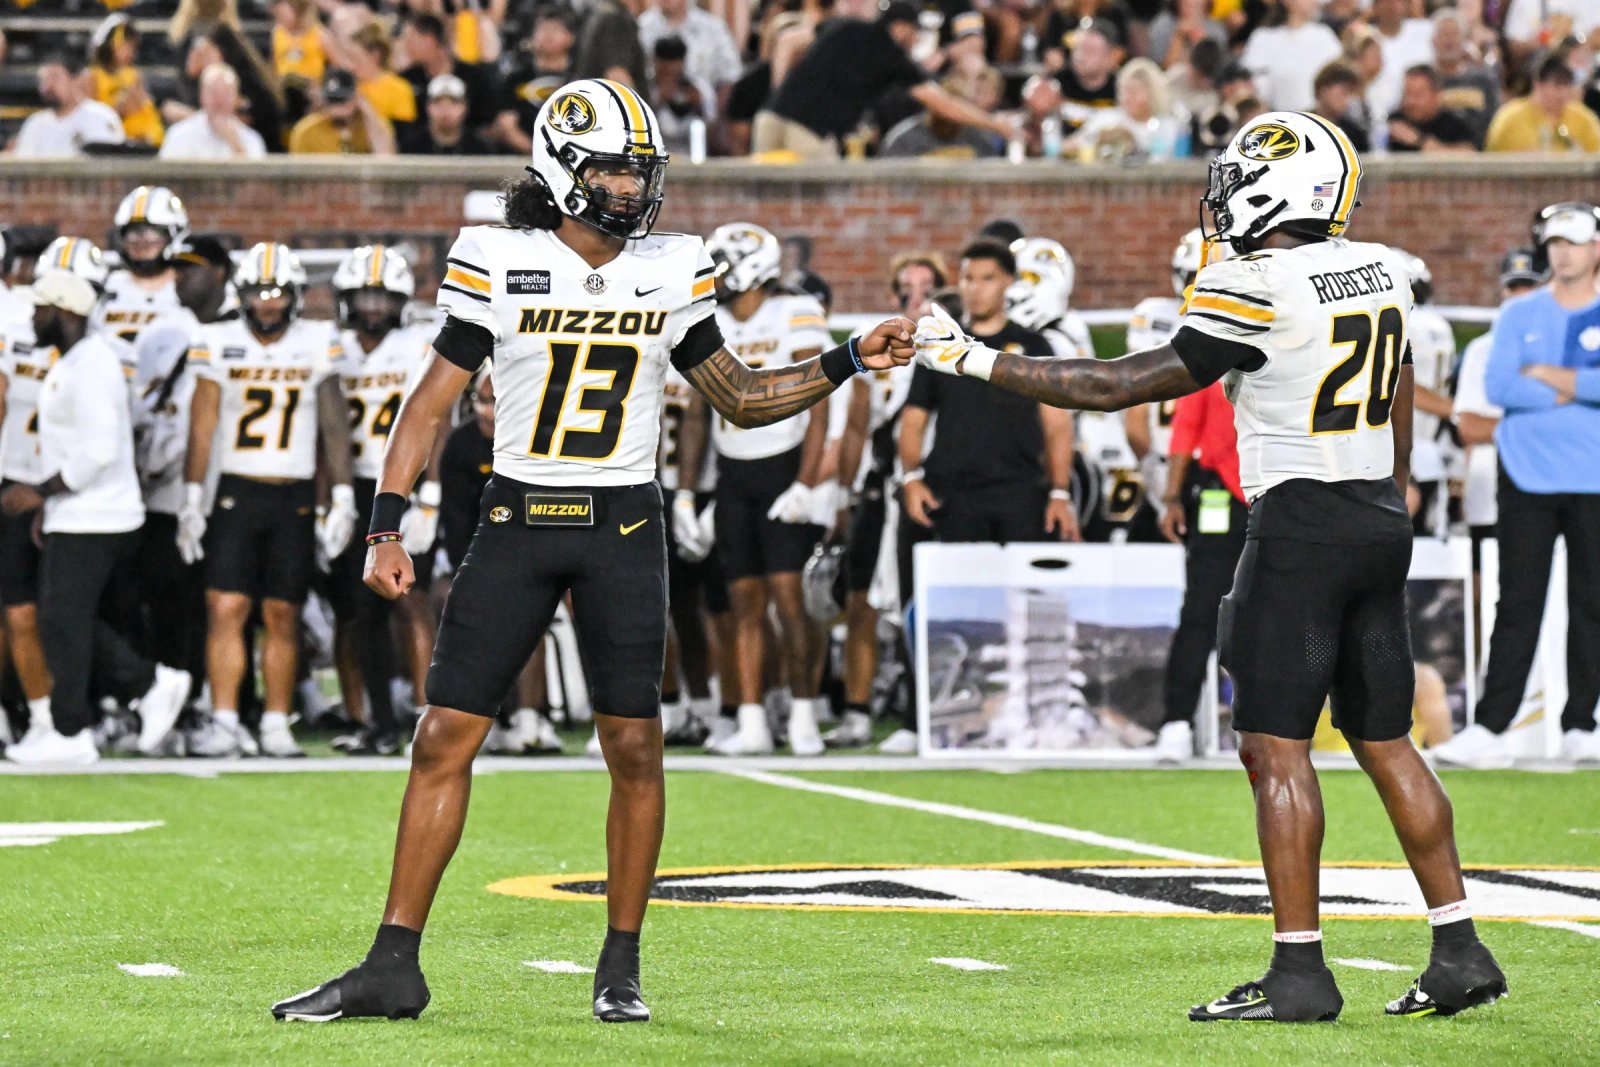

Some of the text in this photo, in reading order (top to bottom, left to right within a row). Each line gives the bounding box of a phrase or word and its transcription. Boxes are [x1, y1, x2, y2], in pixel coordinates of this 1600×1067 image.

[507, 273, 550, 285] ambetter
[587, 274, 604, 290] SEC
[1308, 261, 1395, 305] ROBERTS
[517, 308, 669, 336] MIZZOU
[1309, 304, 1404, 437] 20
[234, 385, 302, 451] 21
[527, 339, 642, 462] 13
[529, 504, 589, 516] MIZZOU
